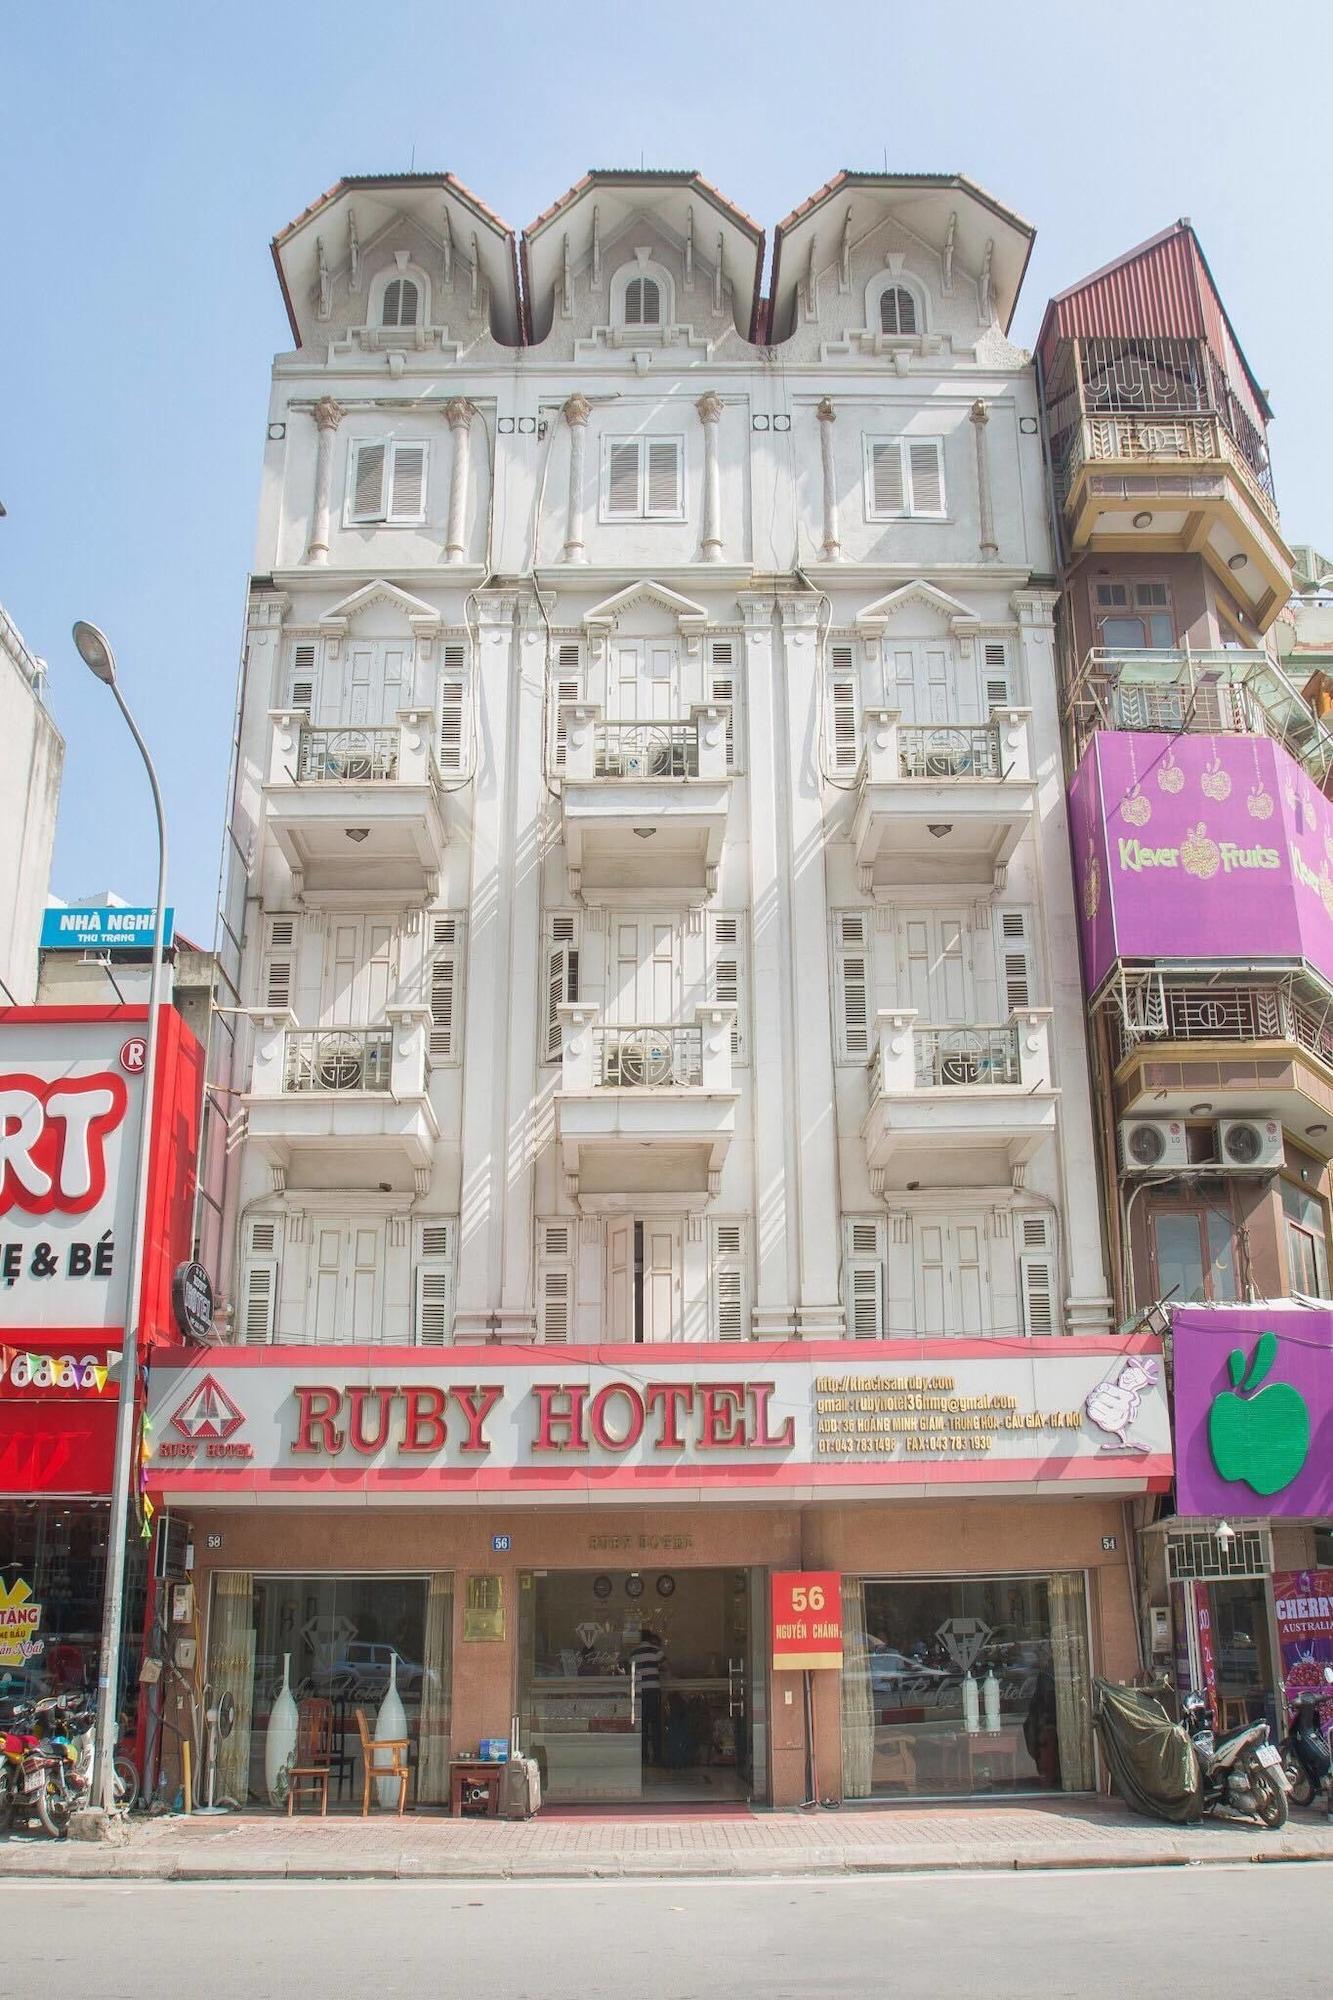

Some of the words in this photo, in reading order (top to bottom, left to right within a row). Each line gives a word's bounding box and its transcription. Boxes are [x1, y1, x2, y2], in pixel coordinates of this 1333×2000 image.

[1118, 838, 1179, 872] Klever
[1219, 843, 1280, 873] Fruits
[60, 911, 102, 931] NHÀ
[101, 933, 135, 943] TRANG
[31, 1242, 59, 1277] &
[68, 1229, 115, 1276] BÉ
[291, 1384, 505, 1456] RUBY
[531, 1381, 796, 1453] HOTEL
[891, 1418, 917, 1431] MINH
[950, 1415, 979, 1431] TRUNG
[208, 1535, 222, 1548] 58
[495, 1537, 508, 1549] 56
[1102, 1538, 1115, 1550] 54
[791, 1585, 825, 1612] 56
[812, 1620, 839, 1639] CHÁNH
